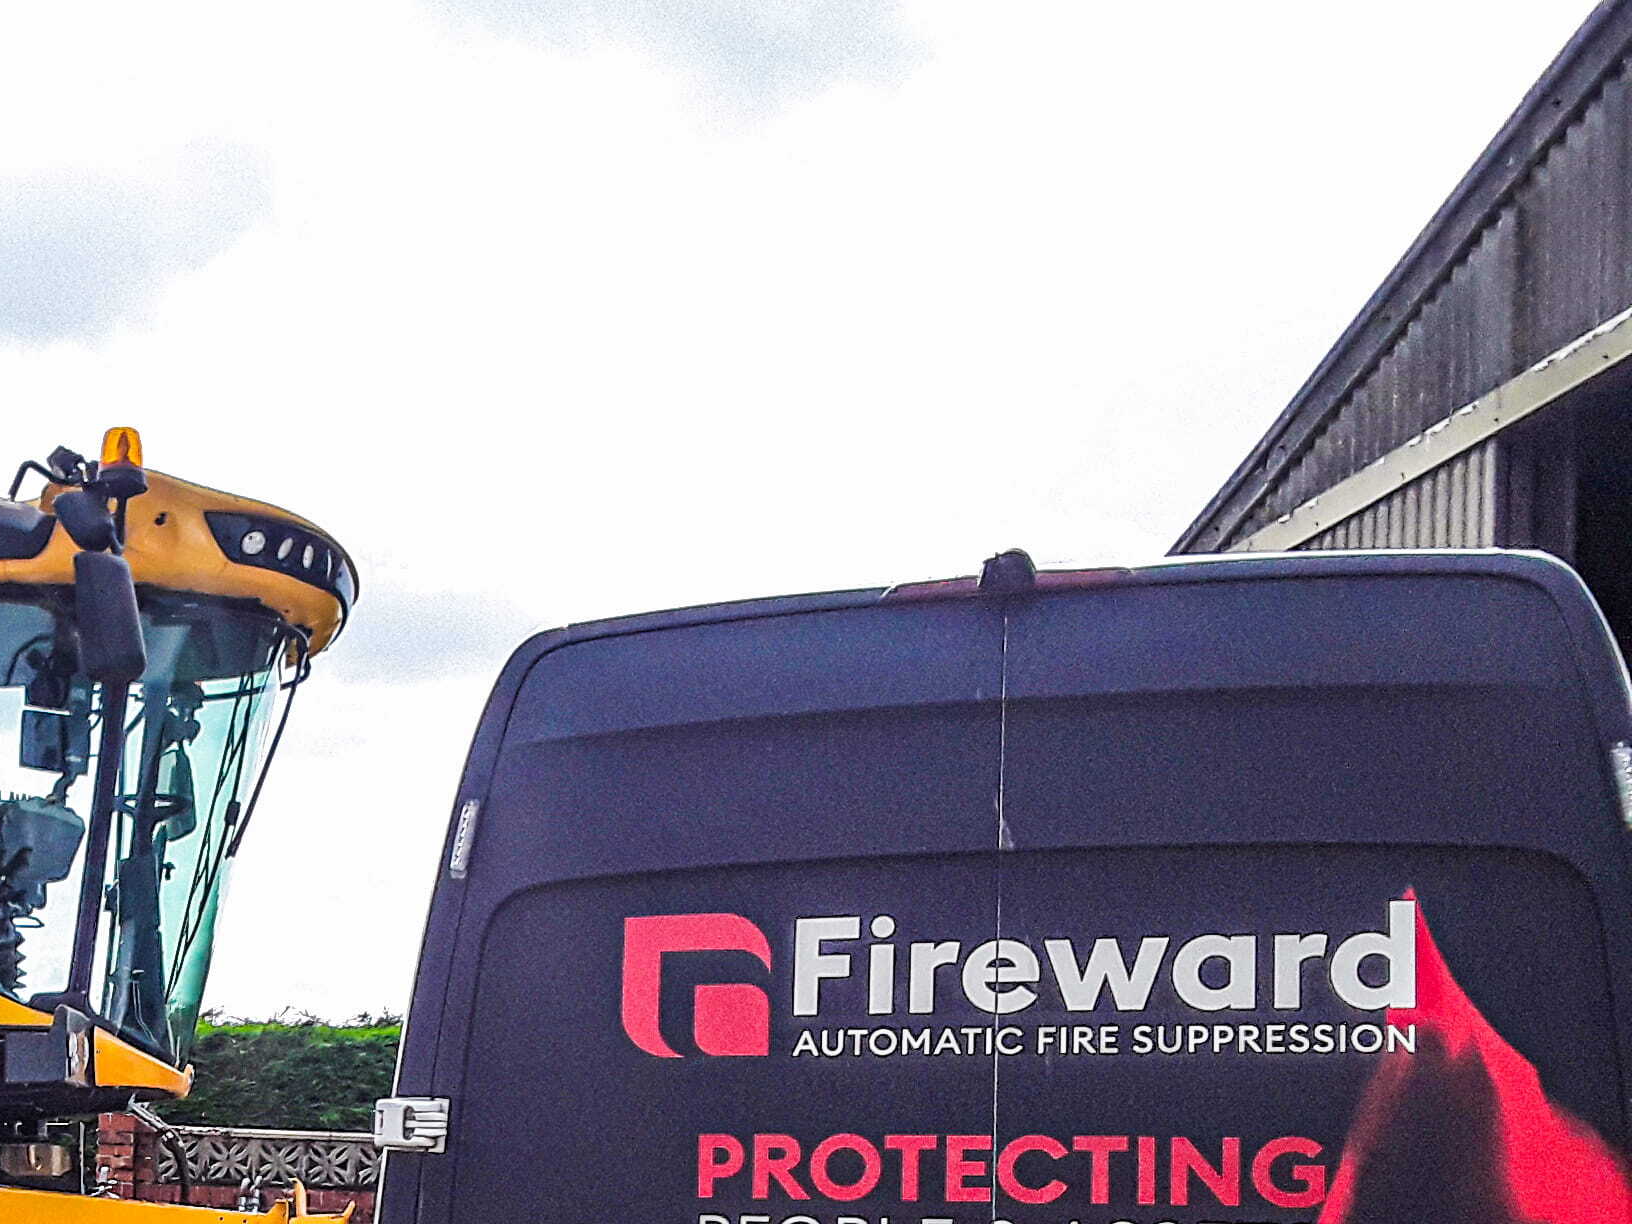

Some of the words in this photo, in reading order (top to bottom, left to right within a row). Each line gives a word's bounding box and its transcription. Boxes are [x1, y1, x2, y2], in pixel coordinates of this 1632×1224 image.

[791, 898, 1418, 1018] Fireward
[792, 1025, 1024, 1058] AUTOMATIC
[1035, 1025, 1120, 1055] FIRE
[1132, 1023, 1418, 1055] SUPPRESSION
[696, 1133, 1327, 1207] PROTECTING
